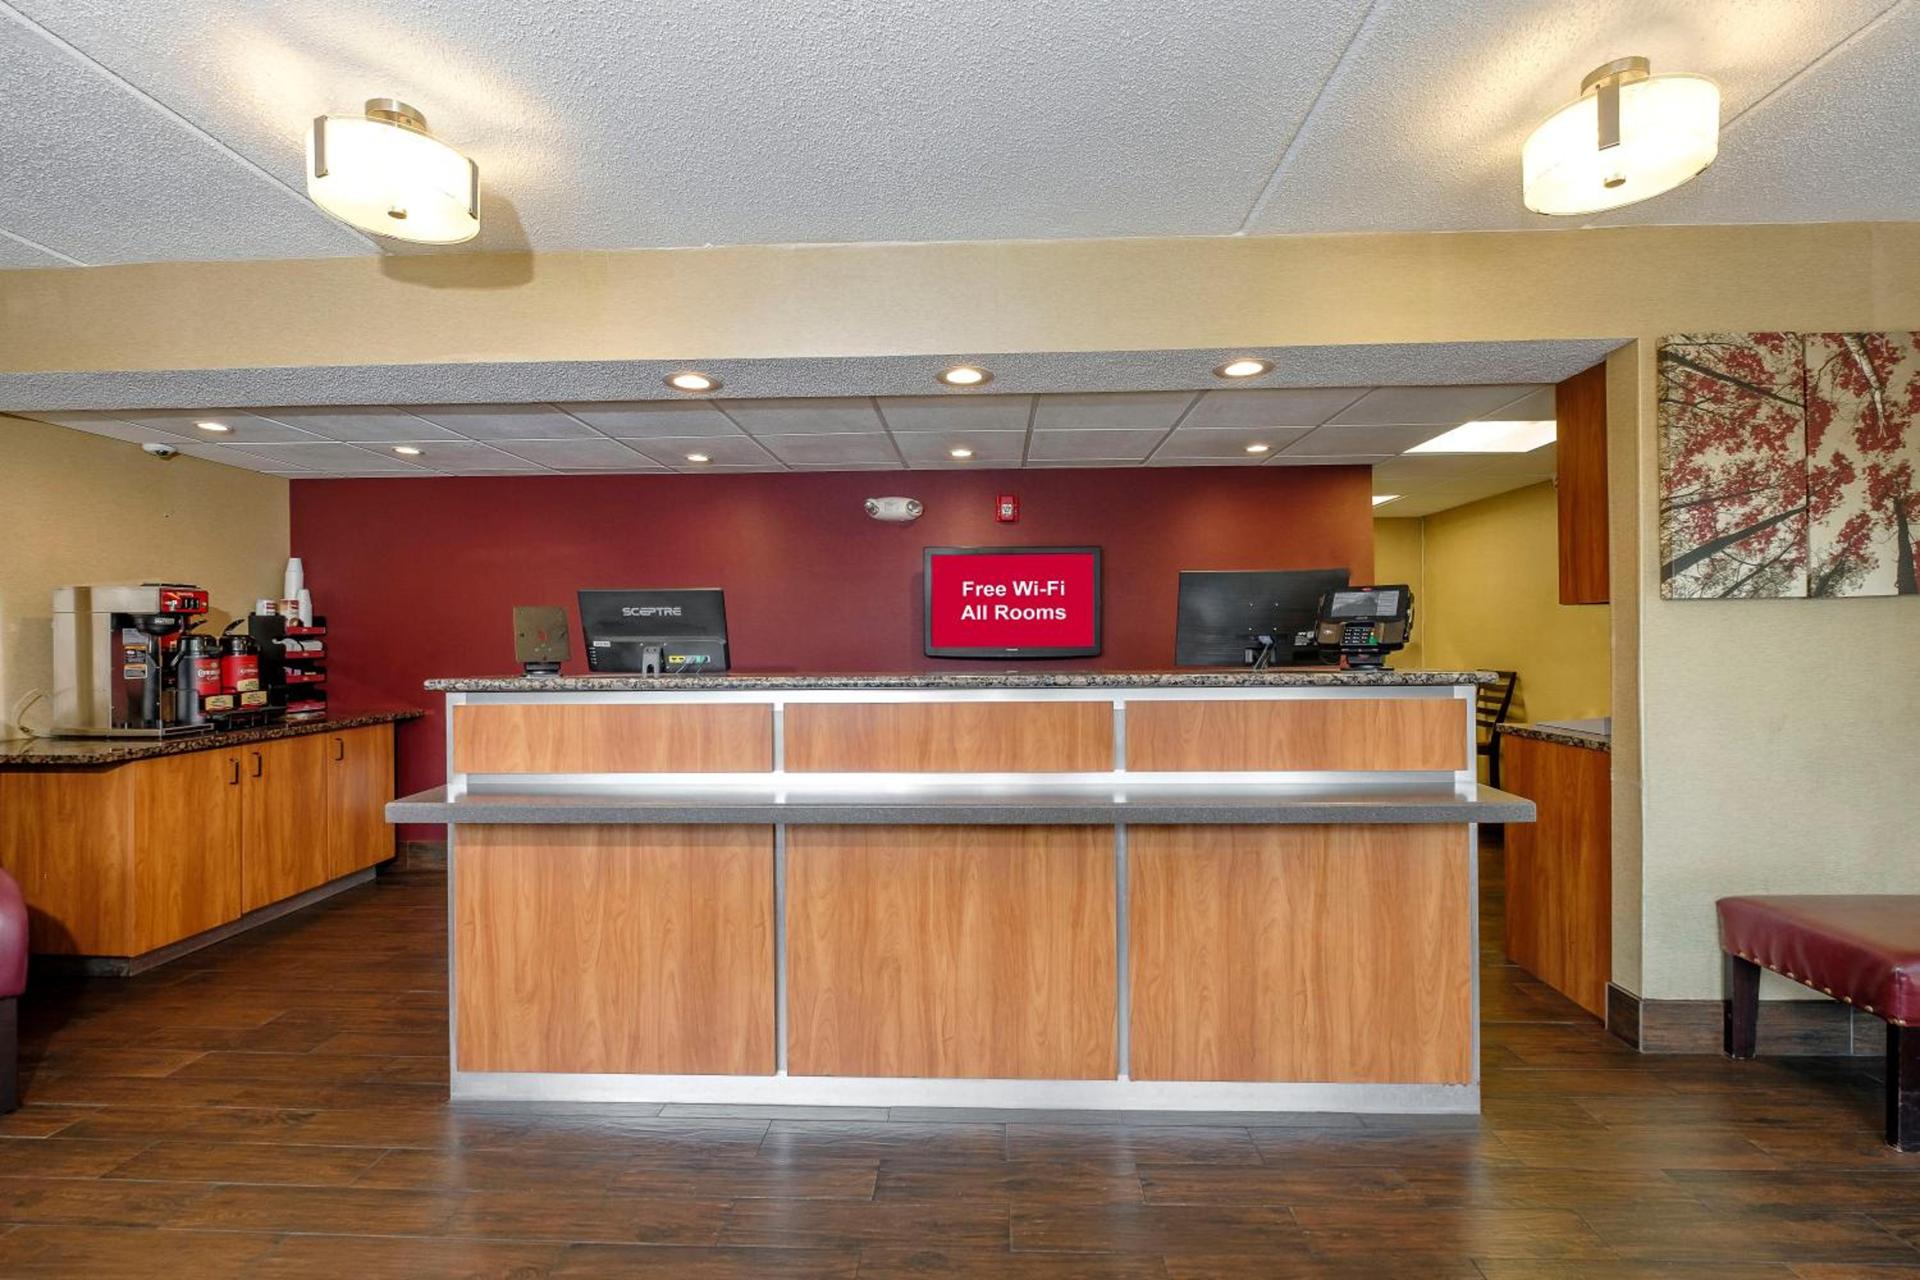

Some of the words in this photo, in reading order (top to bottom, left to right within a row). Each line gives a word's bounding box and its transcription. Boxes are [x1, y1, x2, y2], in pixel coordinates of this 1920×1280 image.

[961, 580, 1007, 597] Free
[1012, 580, 1066, 597] Wi-Fi
[622, 607, 682, 617] SCEPTRE
[961, 605, 988, 621] All
[994, 604, 1067, 621] Rooms
